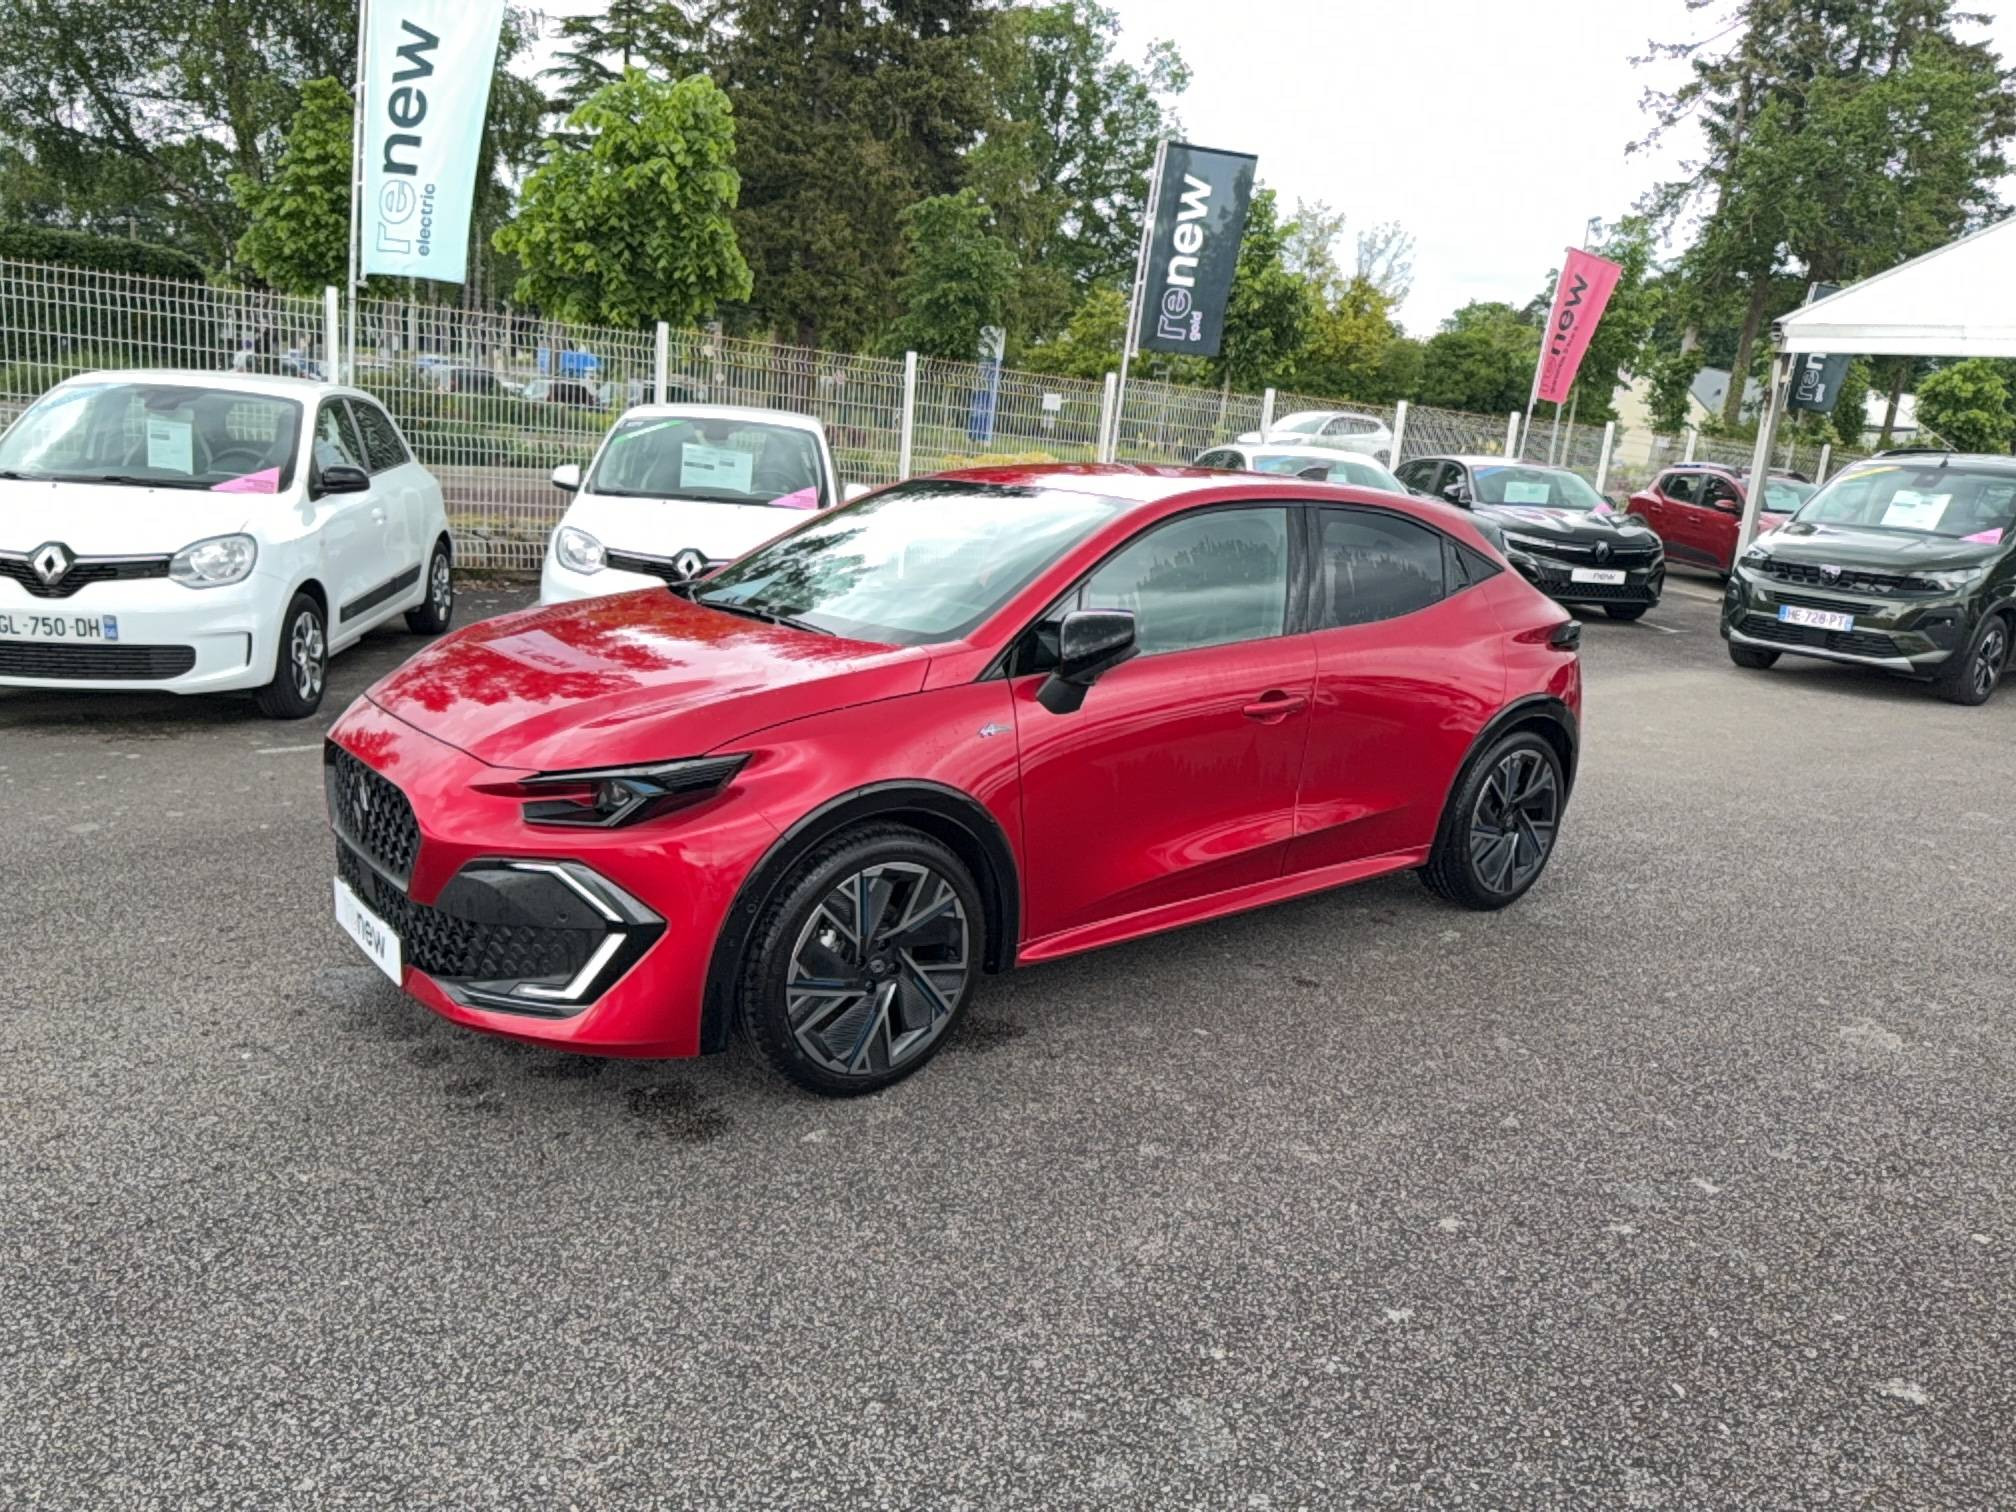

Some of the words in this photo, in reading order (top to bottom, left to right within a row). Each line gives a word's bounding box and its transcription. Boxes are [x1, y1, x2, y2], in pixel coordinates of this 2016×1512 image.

[375, 18, 440, 255] renew
[415, 183, 436, 257] electric
[1157, 173, 1212, 341] renew
